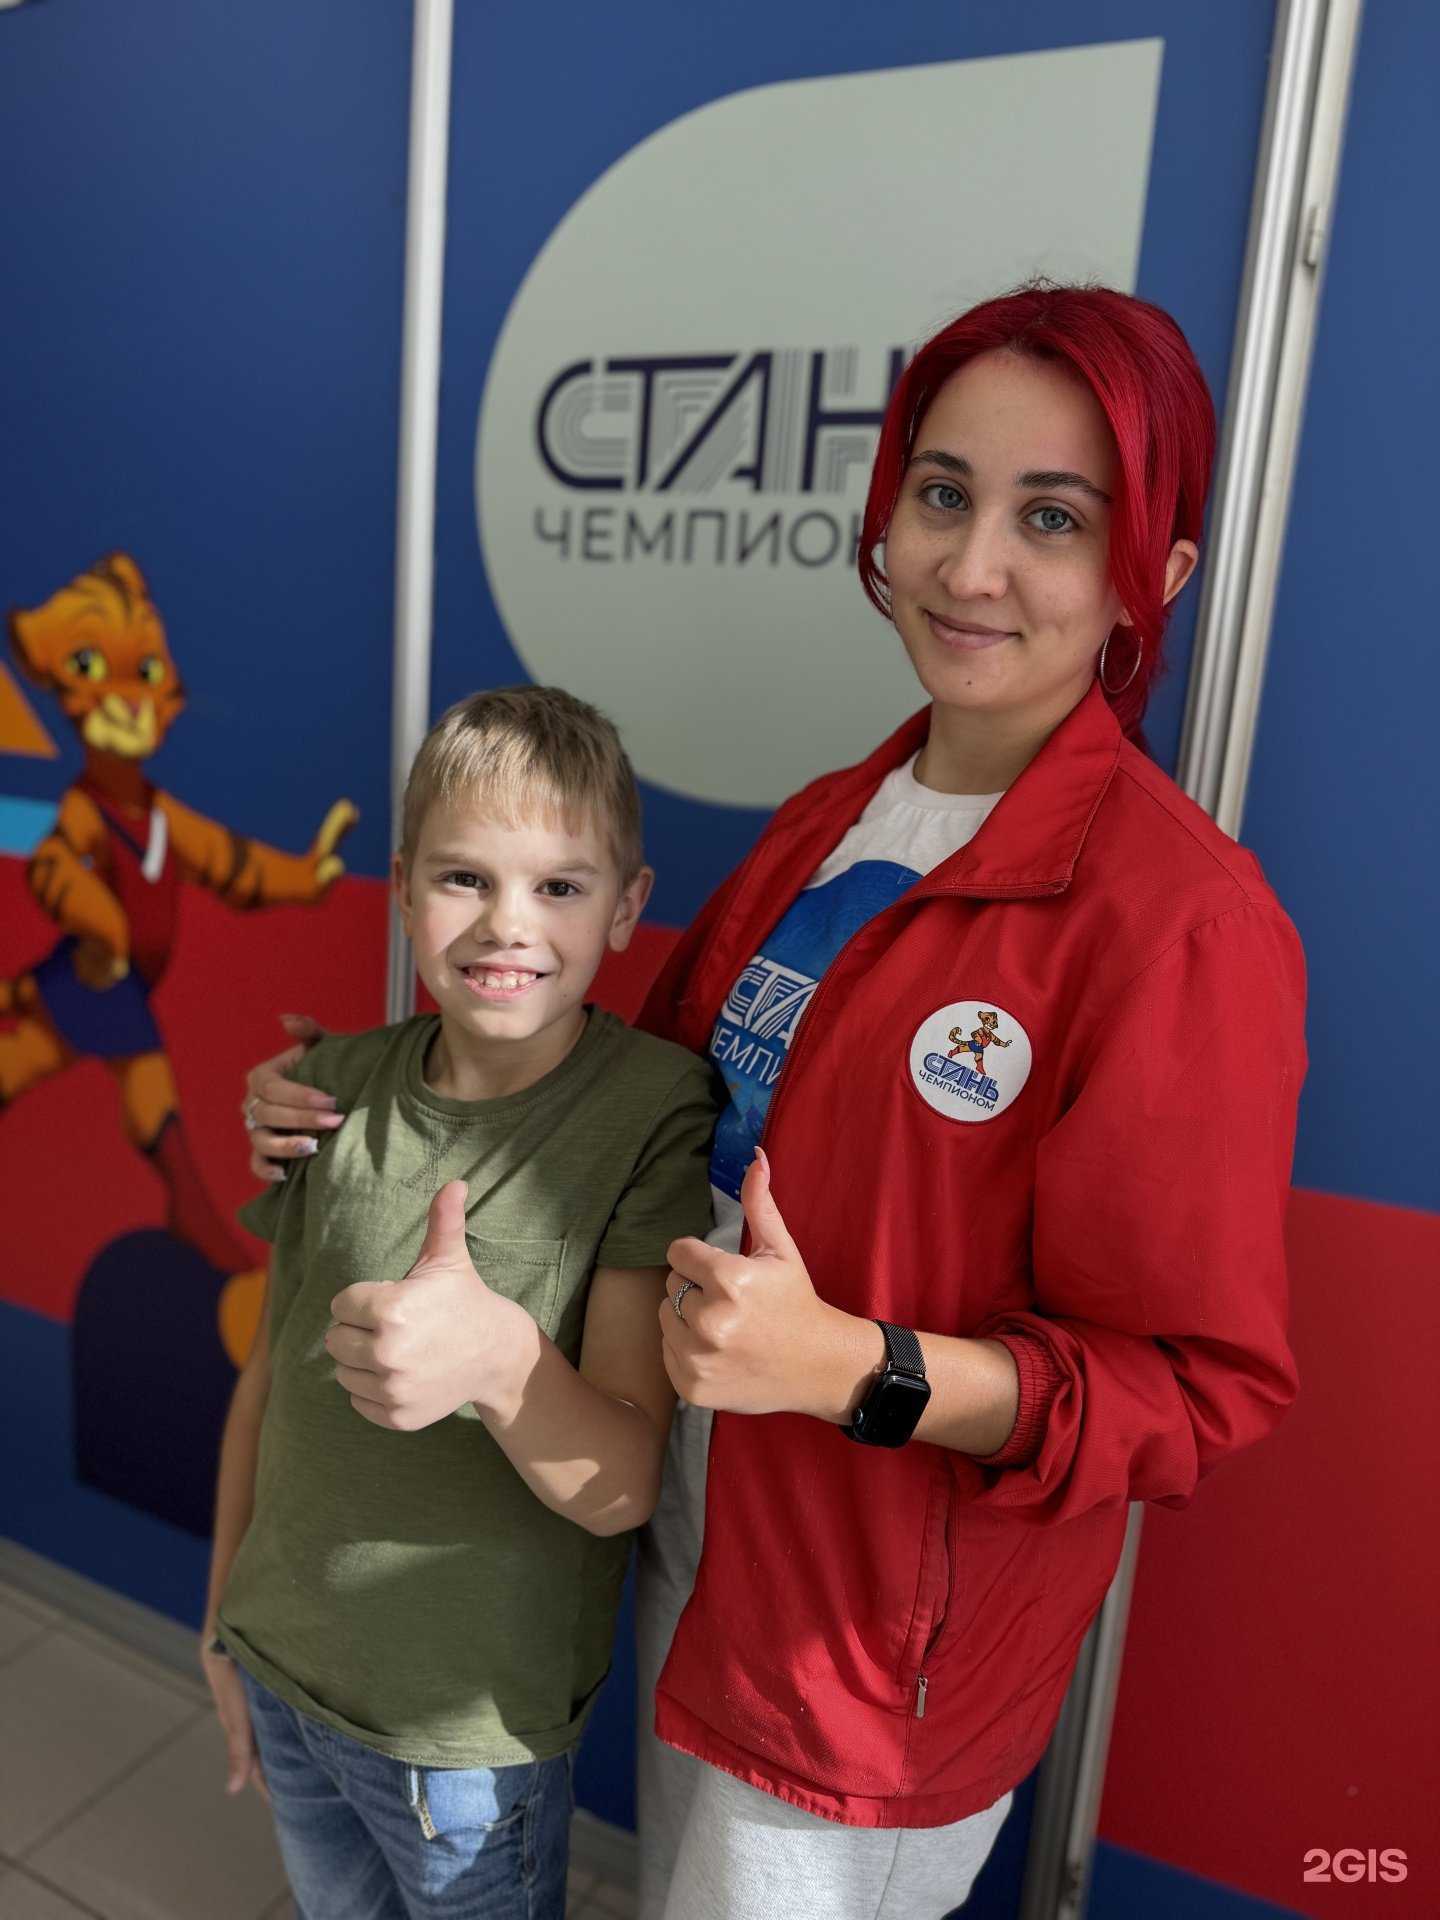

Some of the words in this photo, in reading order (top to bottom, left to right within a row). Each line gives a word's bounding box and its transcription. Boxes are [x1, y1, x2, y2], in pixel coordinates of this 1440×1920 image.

[534, 347, 908, 493] СТАН
[720, 955, 820, 1051] СТА
[918, 1069, 996, 1112] ЧЕМПИОНОМ
[923, 1052, 1000, 1102] СТАНЬ
